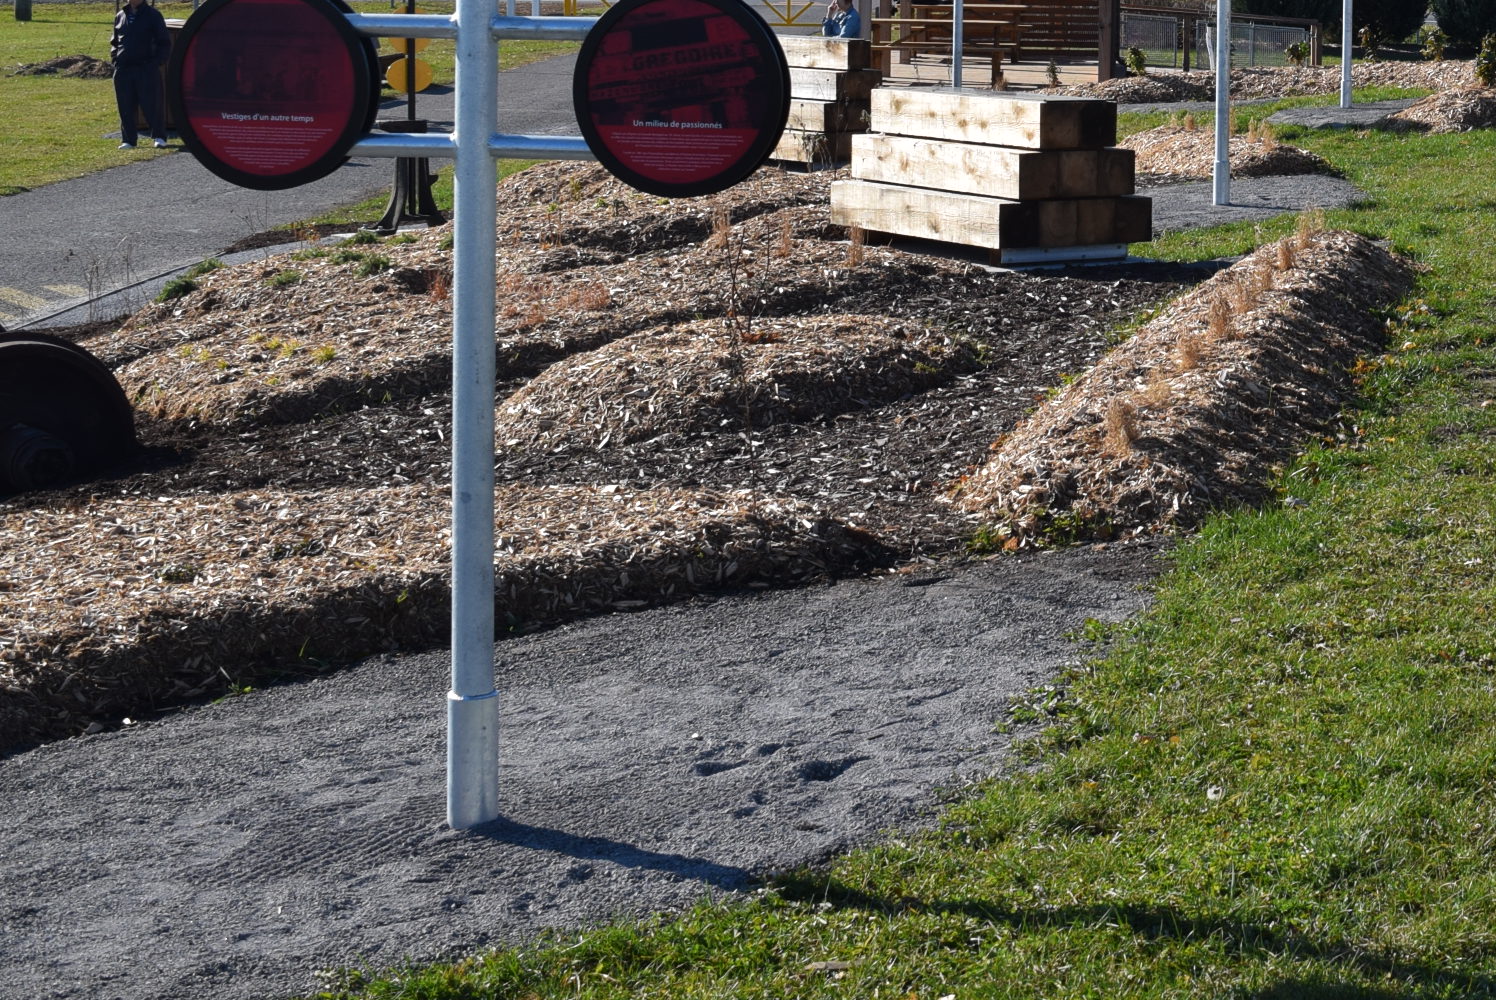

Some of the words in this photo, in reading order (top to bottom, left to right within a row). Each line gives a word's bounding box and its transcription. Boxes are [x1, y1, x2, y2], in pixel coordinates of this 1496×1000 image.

[221, 112, 252, 122] Vestiges
[291, 115, 314, 123] temps
[645, 120, 669, 128] milieu
[670, 120, 680, 128] de
[681, 121, 722, 129] passionnés
